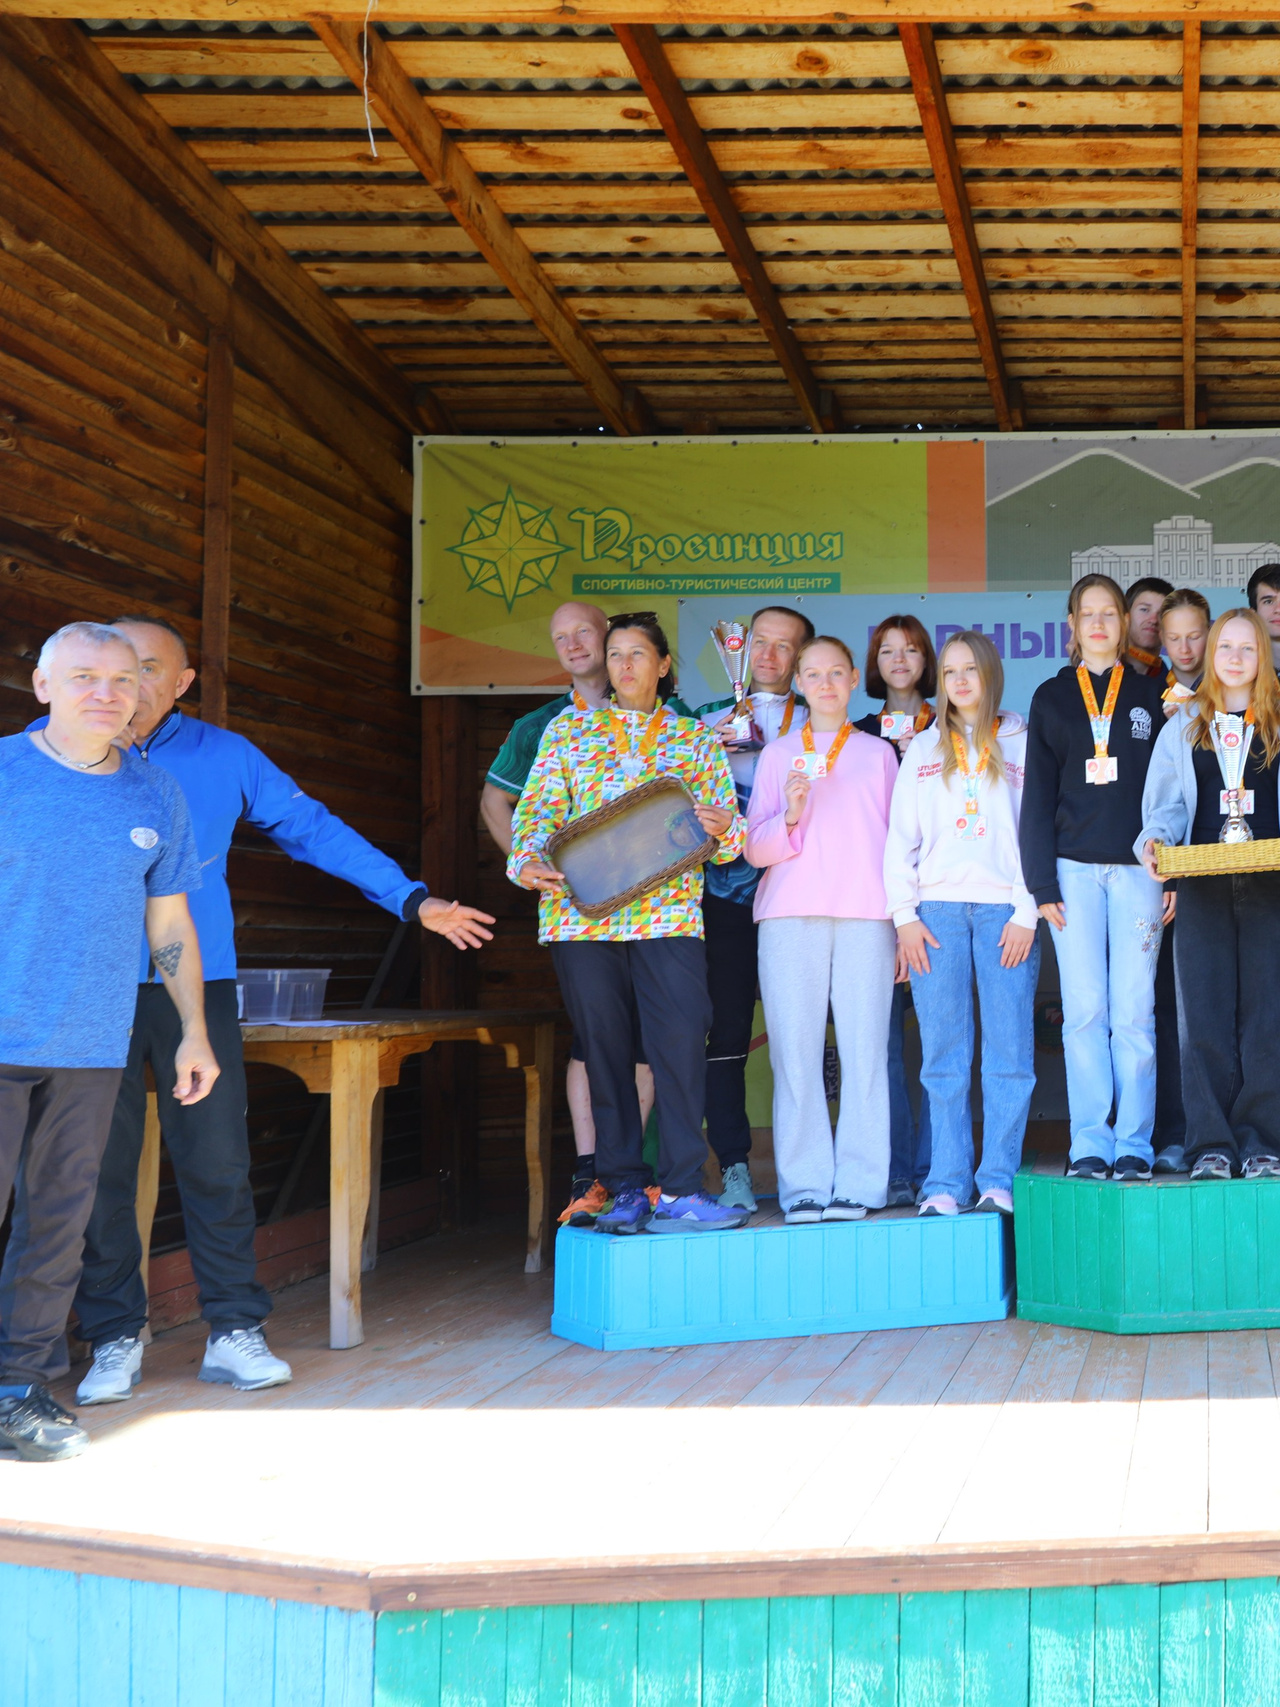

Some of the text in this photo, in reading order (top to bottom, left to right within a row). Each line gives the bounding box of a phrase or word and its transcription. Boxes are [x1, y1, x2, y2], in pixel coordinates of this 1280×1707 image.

[568, 507, 843, 572] Провинция
[581, 577, 832, 591] СПОРТИВНО-ТУРИСТИЧЕСКИЙ ЦЕНТР
[818, 765, 825, 775] 2
[977, 827, 985, 836] 2
